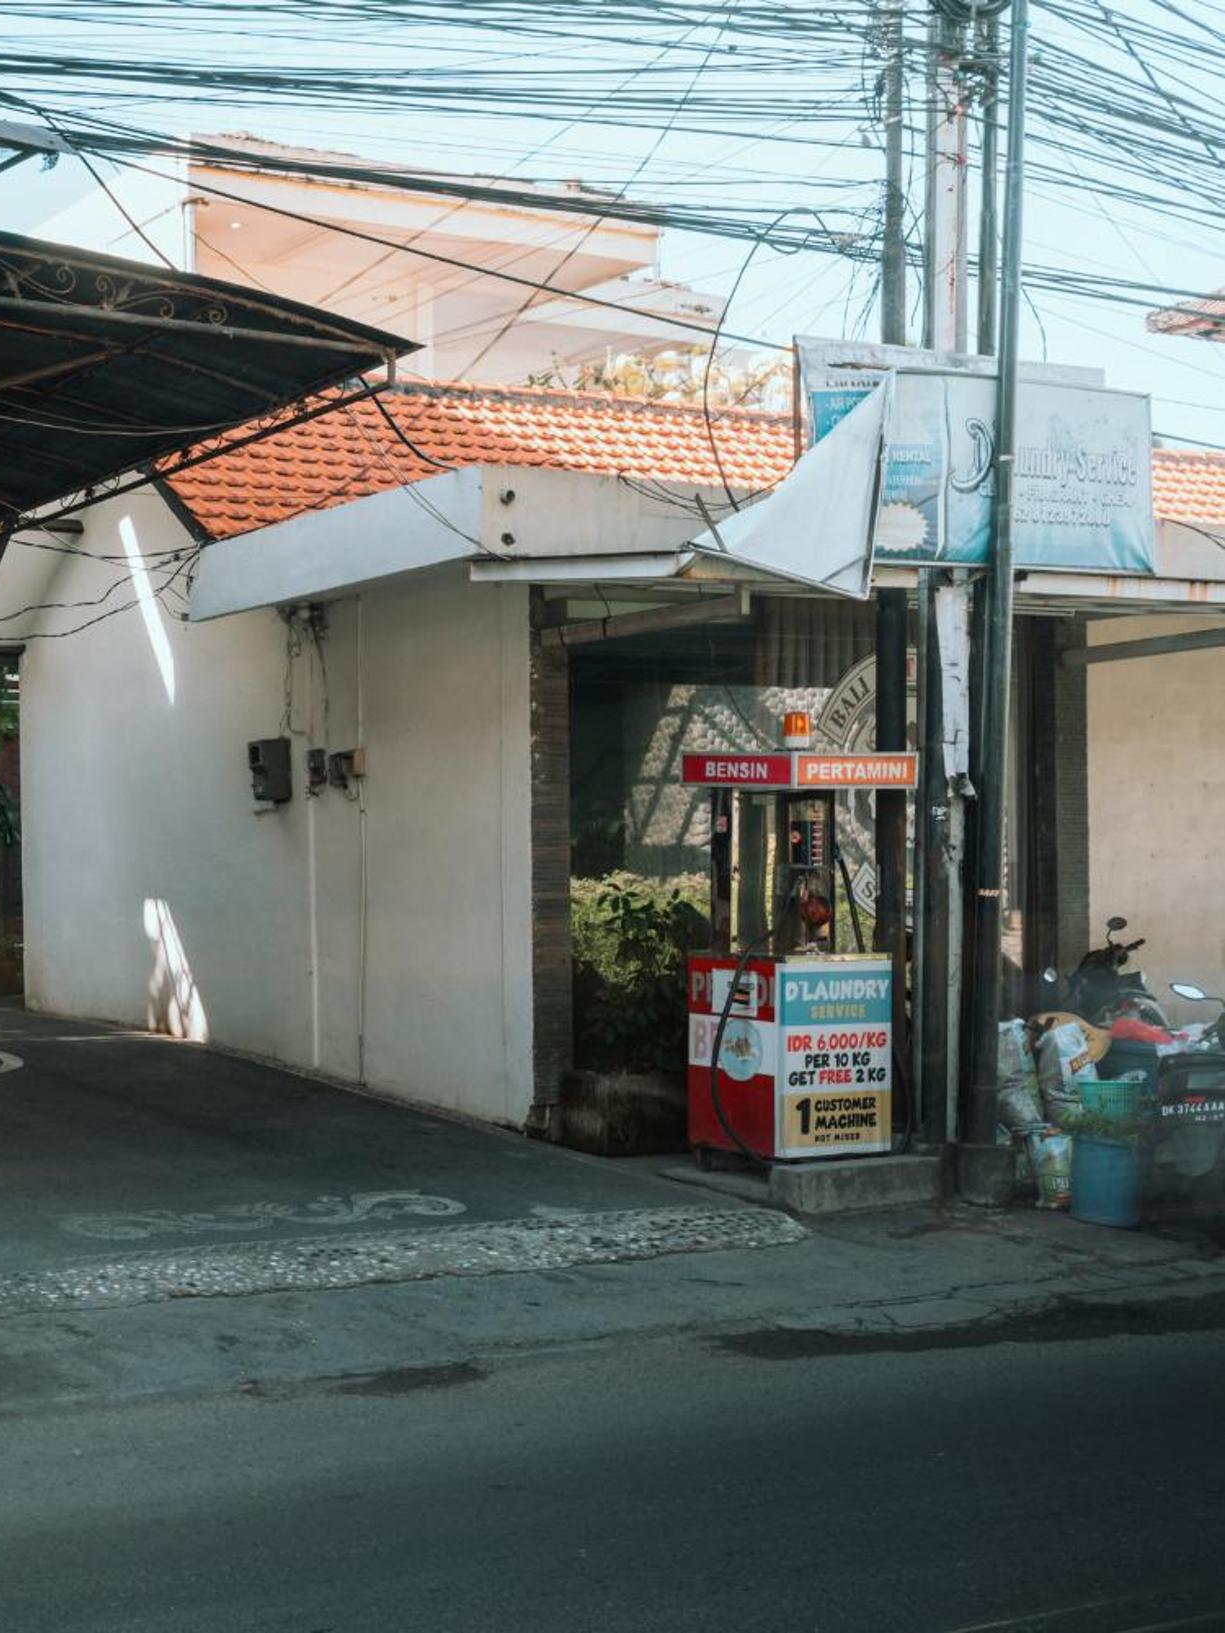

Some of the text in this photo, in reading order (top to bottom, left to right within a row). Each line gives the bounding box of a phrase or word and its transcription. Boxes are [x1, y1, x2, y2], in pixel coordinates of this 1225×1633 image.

[831, 676, 870, 729] BALI
[705, 762, 908, 780] BENSIN PERTAMINI
[785, 979, 889, 1001] D'LAUNDRY
[810, 1004, 866, 1020] SERVICE
[787, 1034, 812, 1052] IDR
[805, 1051, 871, 1068] PER 10 KG
[788, 1067, 886, 1086] GET FREE 2 KG
[815, 1097, 876, 1112] CUSTOMER
[796, 1098, 811, 1135] 1
[814, 1112, 877, 1130] MACHINE
[815, 1132, 860, 1142] NOT MIXED
